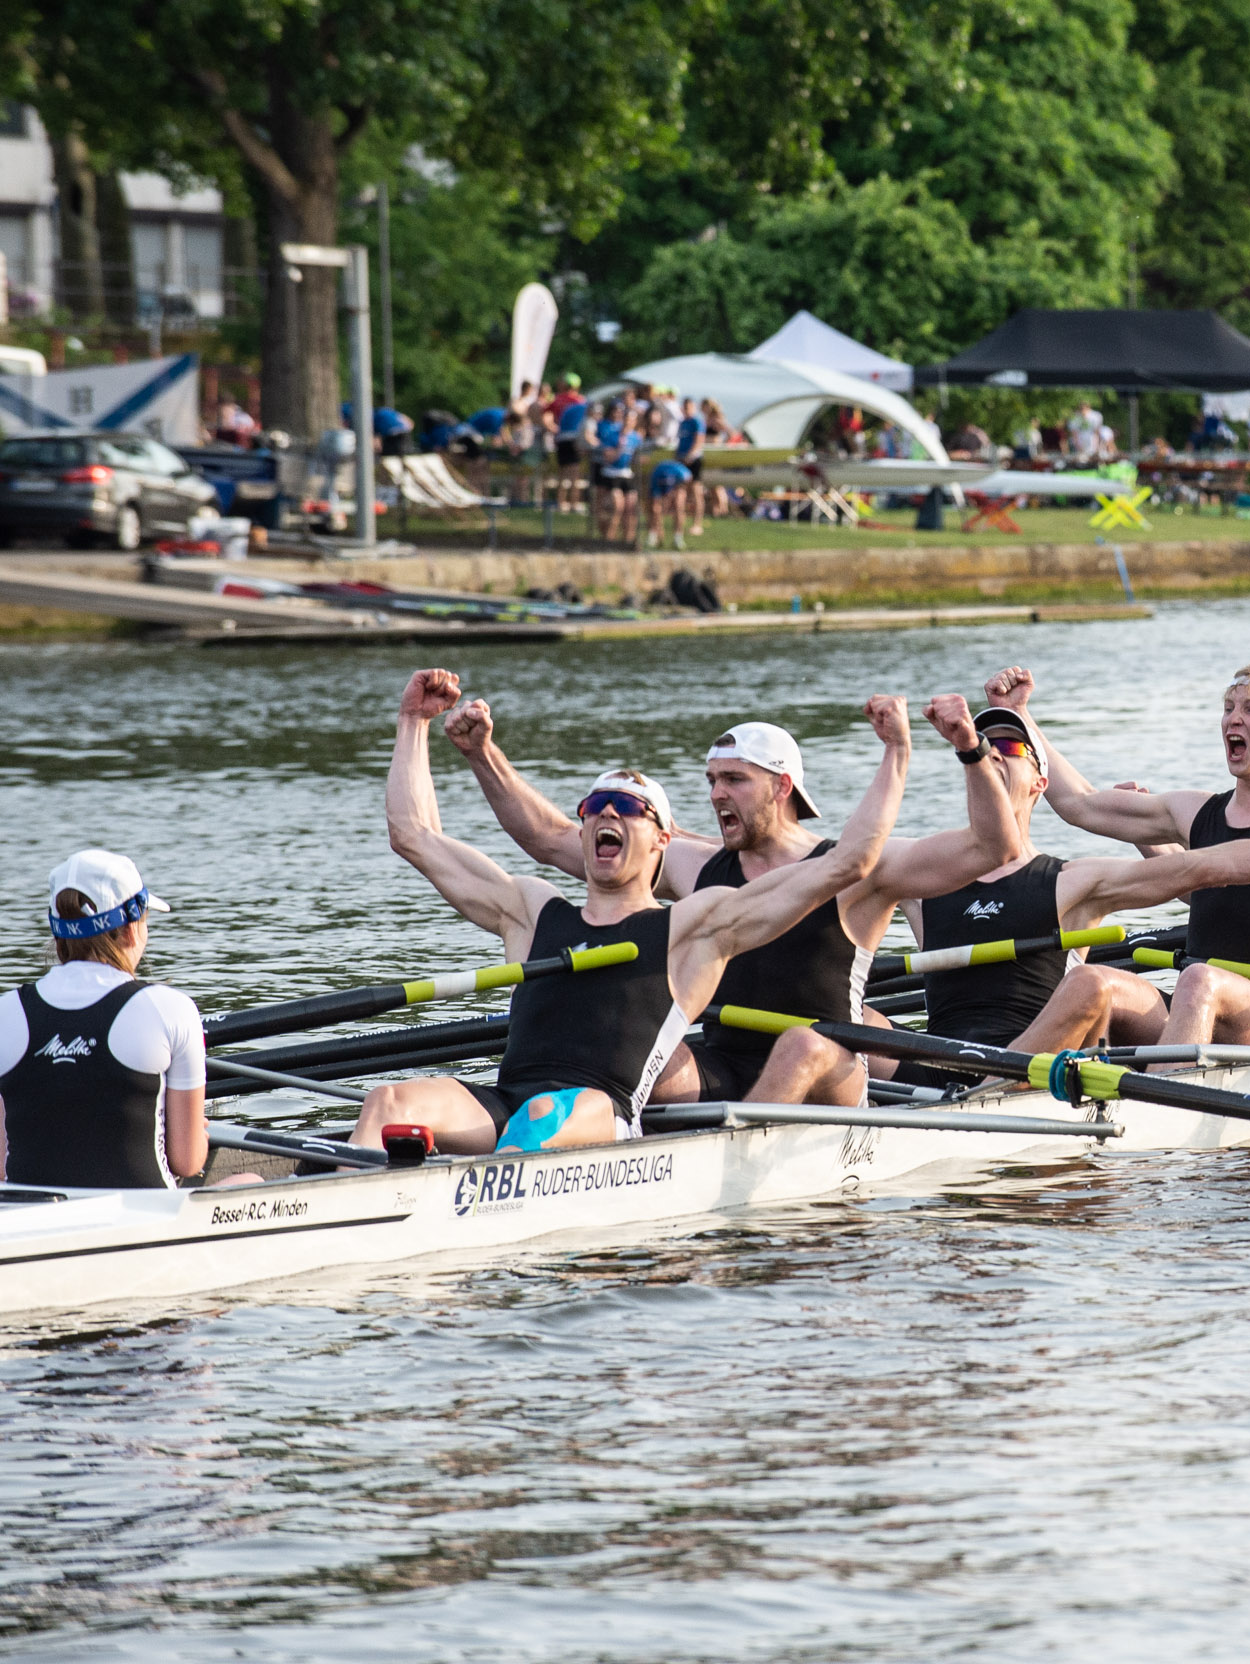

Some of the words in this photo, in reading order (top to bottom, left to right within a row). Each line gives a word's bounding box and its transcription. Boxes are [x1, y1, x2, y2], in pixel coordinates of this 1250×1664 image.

[92, 914, 111, 933] NK
[479, 1162, 526, 1202] RBL
[532, 1154, 673, 1198] RUDER-BUNDESLIGA
[211, 1202, 266, 1225] Bessel-R.C.
[269, 1198, 308, 1219] Minden
